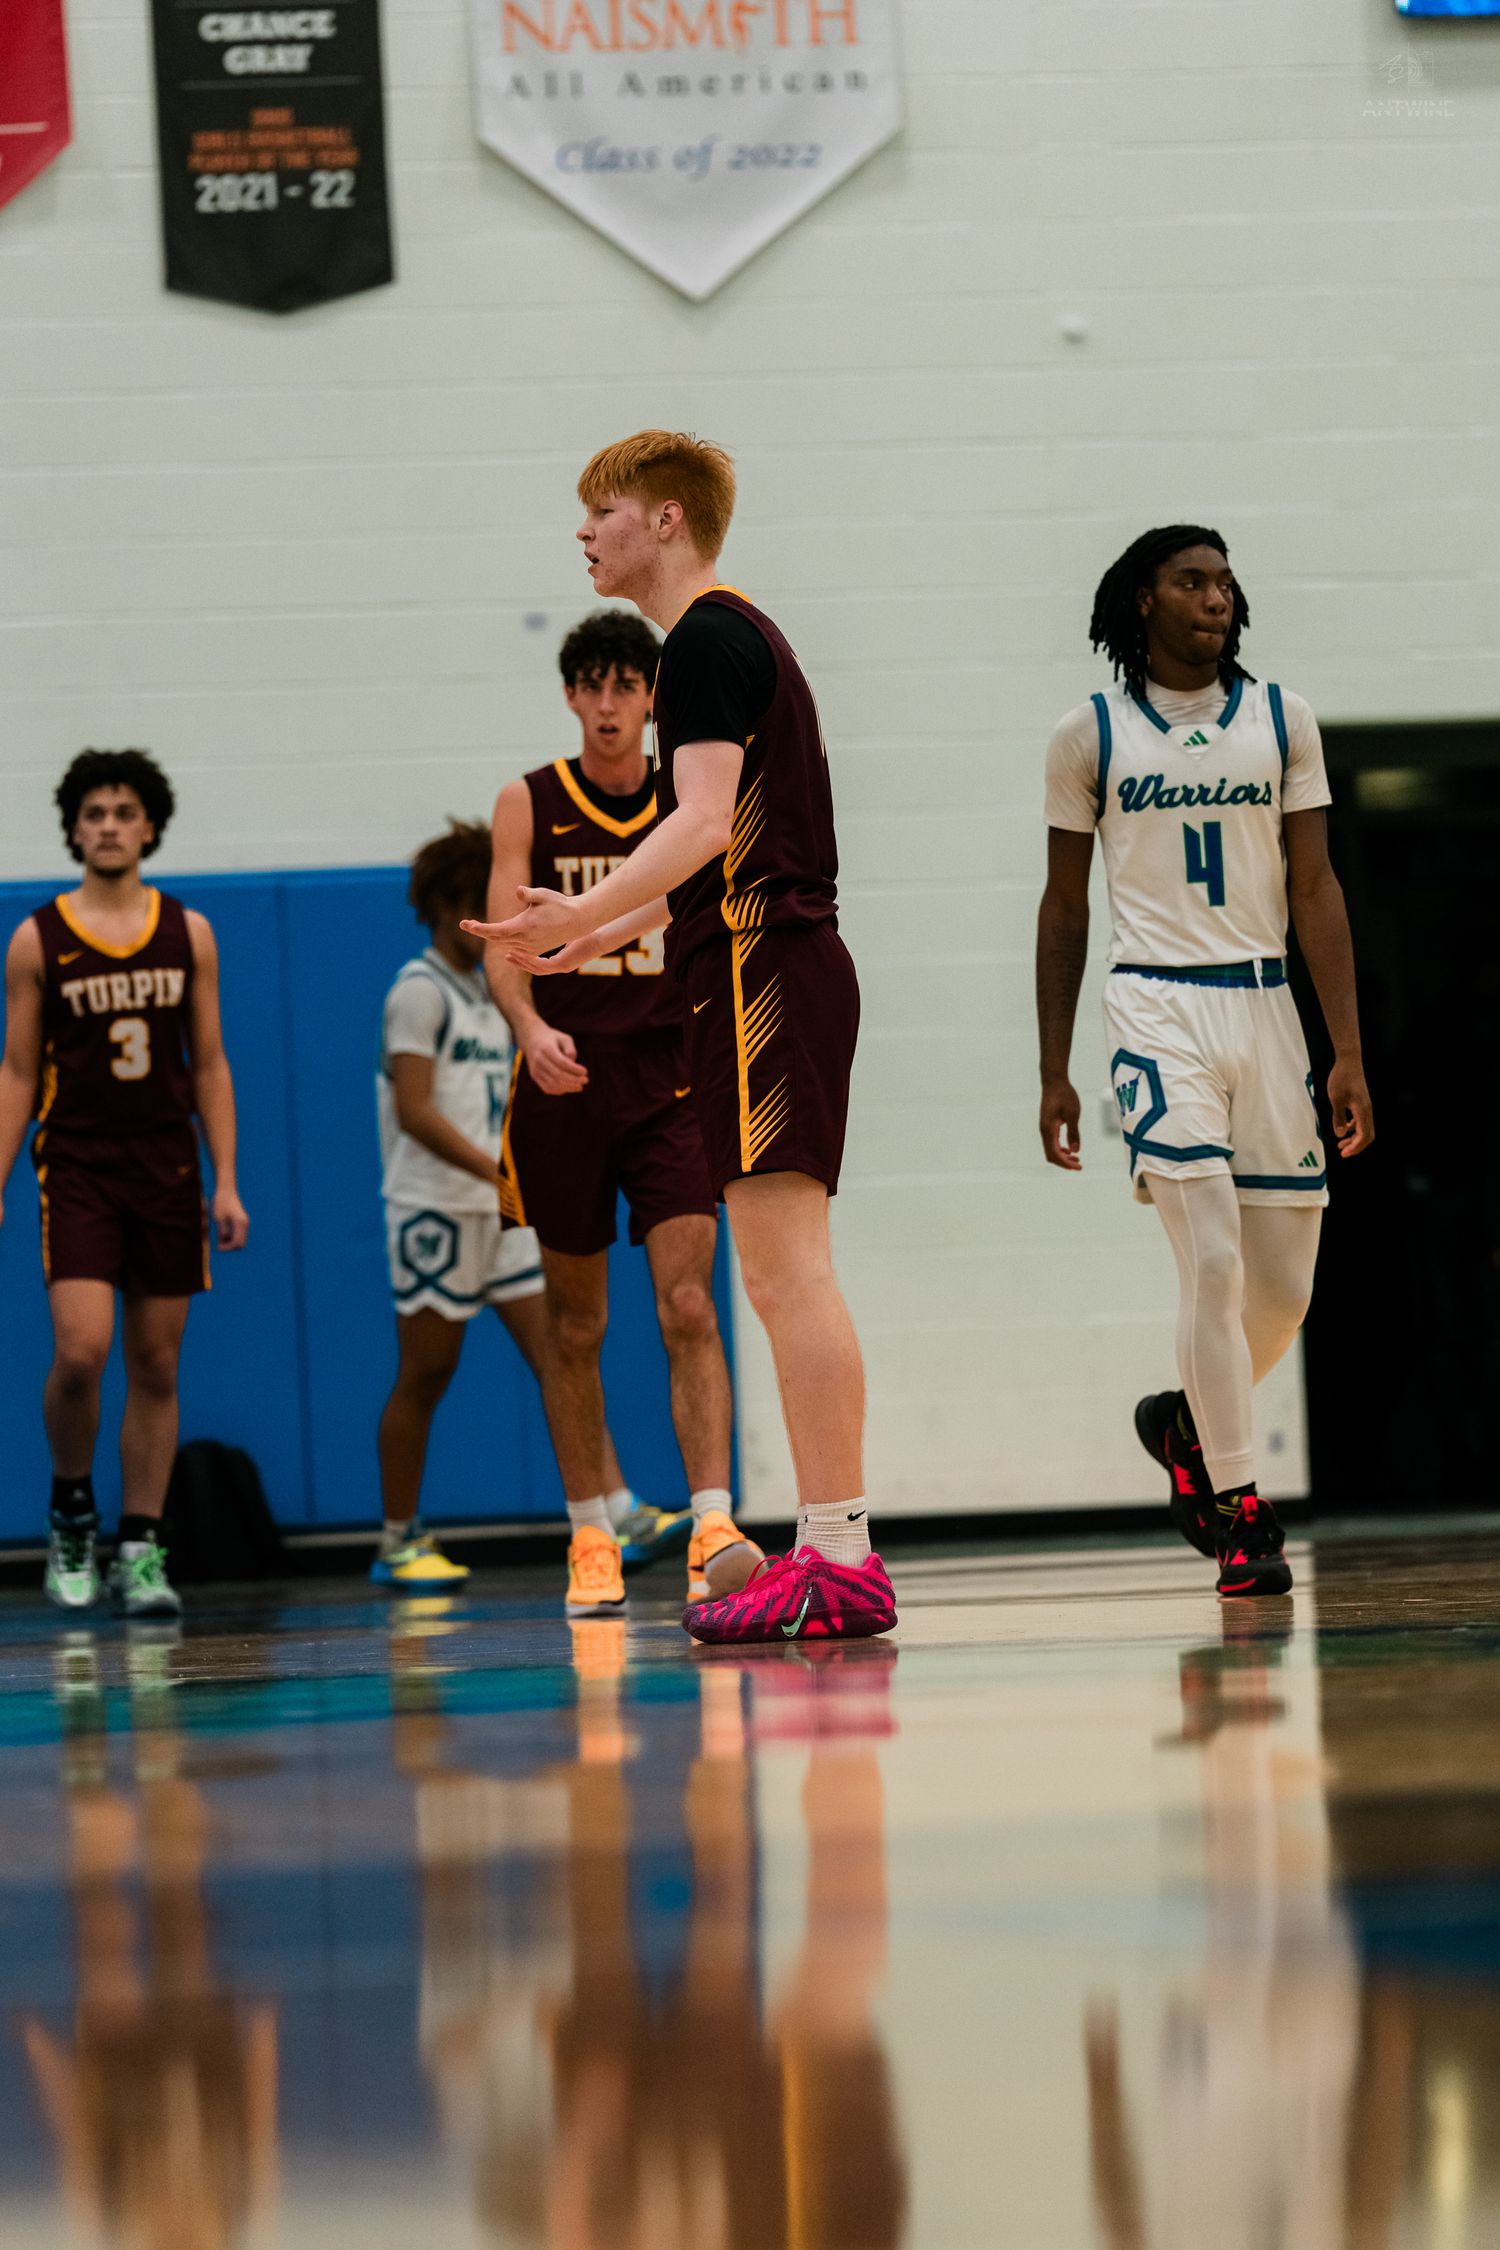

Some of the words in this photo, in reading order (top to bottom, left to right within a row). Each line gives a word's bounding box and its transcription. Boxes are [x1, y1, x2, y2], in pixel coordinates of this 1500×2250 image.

[199, 10, 336, 42] CHANCE
[222, 44, 313, 75] GRAY
[506, 69, 584, 98] All
[618, 66, 868, 98] American
[555, 136, 657, 175] Class
[672, 135, 721, 182] of
[728, 143, 823, 170] 2022
[195, 173, 278, 213] 2021
[309, 169, 355, 209] 22
[1117, 773, 1272, 813] Warriors
[1183, 821, 1225, 907] 4
[61, 968, 185, 1017] TURPIN
[109, 1018, 151, 1081] 3
